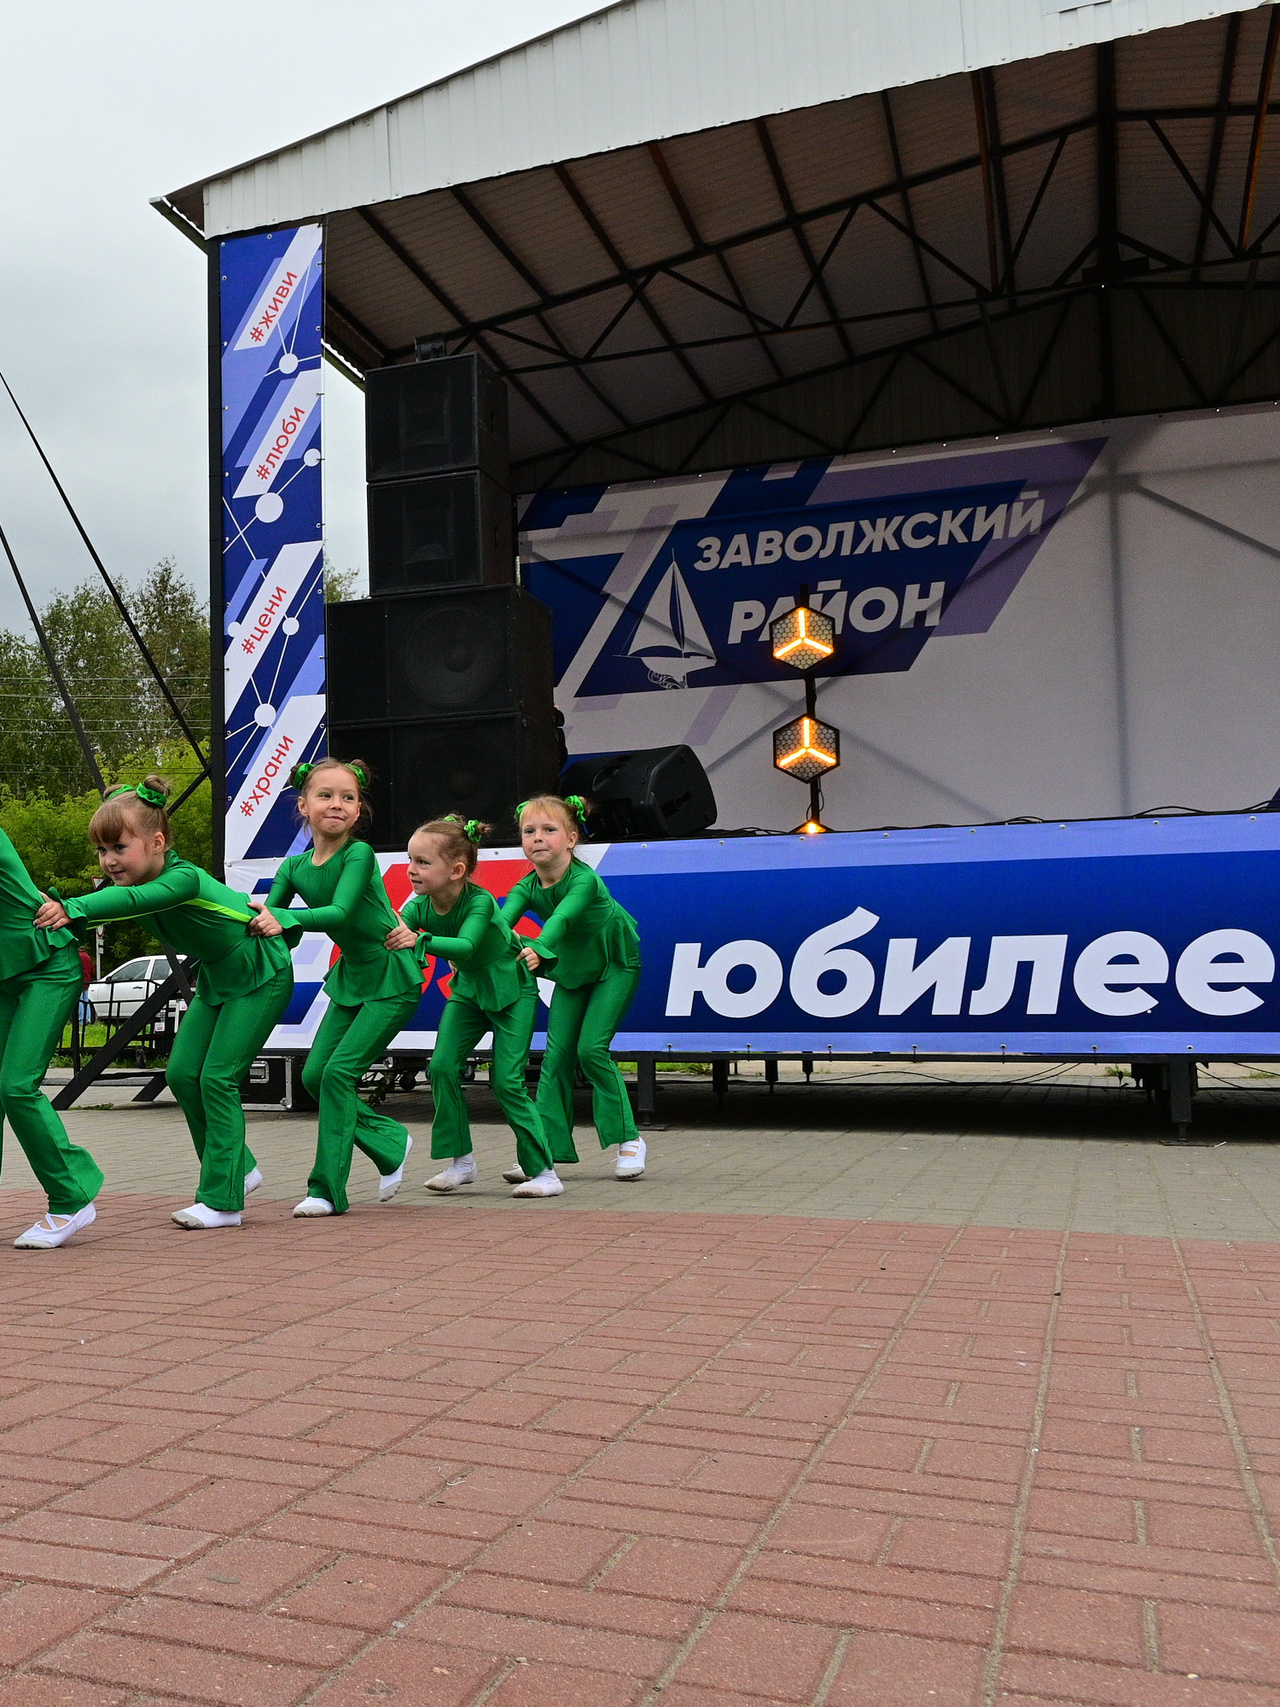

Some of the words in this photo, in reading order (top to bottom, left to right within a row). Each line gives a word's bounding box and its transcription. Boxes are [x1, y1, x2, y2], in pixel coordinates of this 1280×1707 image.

[693, 491, 1045, 572] ЗАВОЛЖСКИЙ
[241, 586, 288, 655] #цени
[239, 735, 294, 817] #храни
